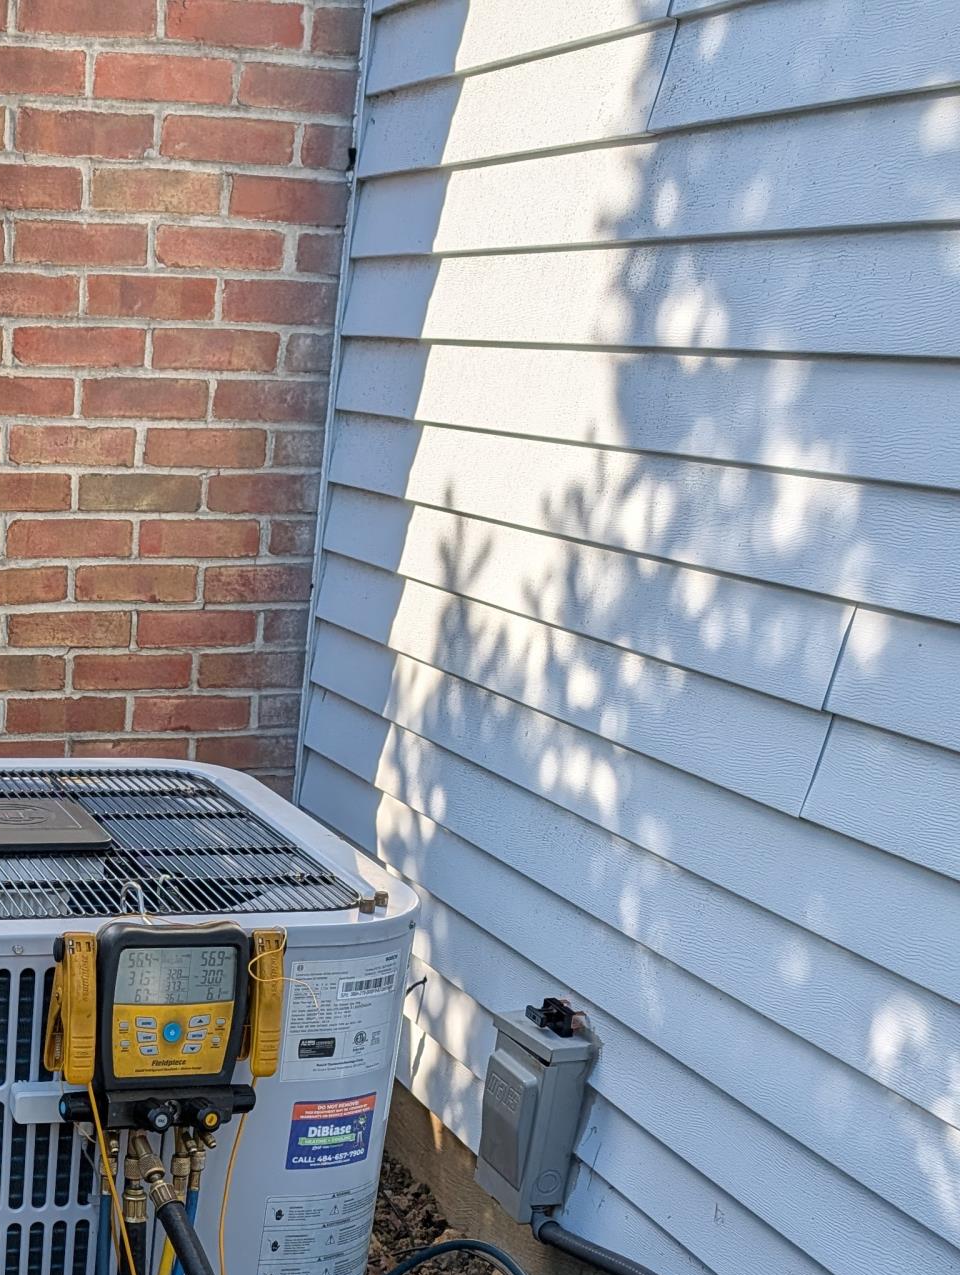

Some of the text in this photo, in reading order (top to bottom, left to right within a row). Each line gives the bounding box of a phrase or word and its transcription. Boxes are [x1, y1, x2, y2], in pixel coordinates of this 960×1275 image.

[152, 1059, 187, 1067] Fieldpiece
[307, 1124, 352, 1138] DiBiase
[292, 1156, 315, 1164] CALL:
